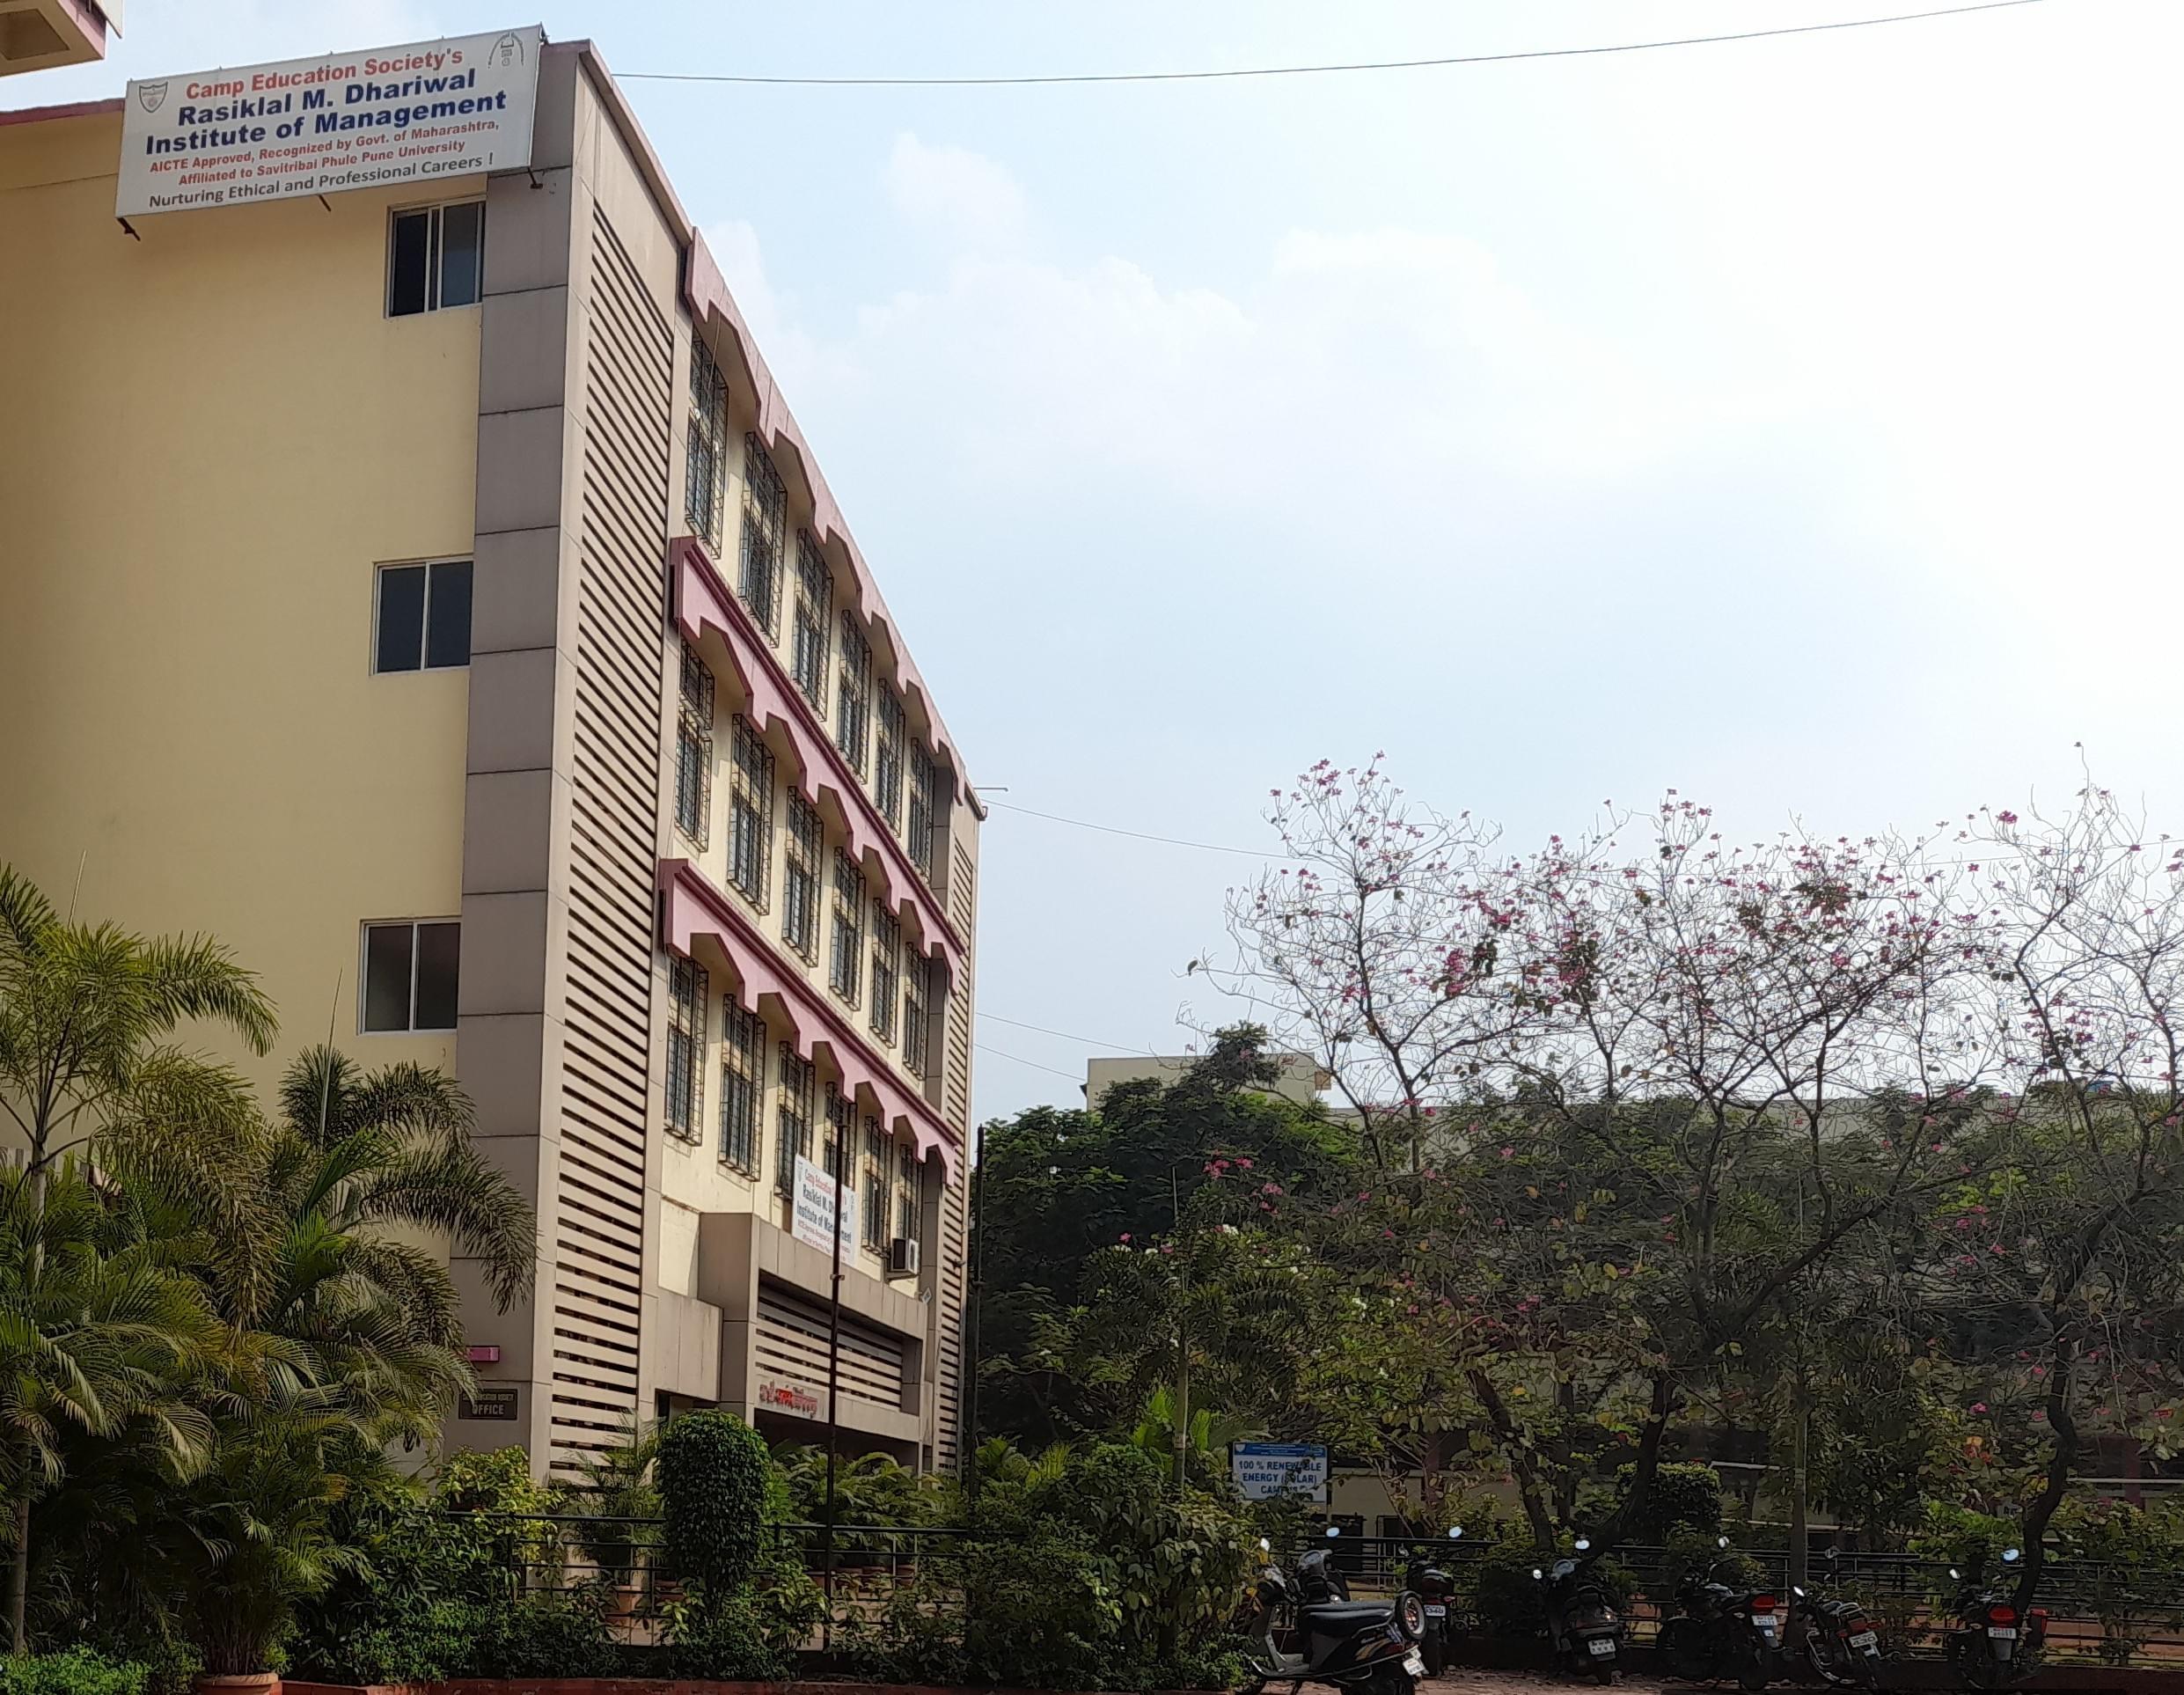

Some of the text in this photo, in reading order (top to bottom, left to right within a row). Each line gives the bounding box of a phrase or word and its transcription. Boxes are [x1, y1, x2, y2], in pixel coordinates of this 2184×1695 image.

[179, 68, 476, 127] Rasiklal M. Dhariwal
[186, 48, 463, 99] Camp Education Society's
[146, 90, 507, 155] Institute of Management
[150, 121, 499, 172] AICTE Approved, Recognized by Govt. of Maharashtra,
[149, 189, 224, 208] Nurturing
[228, 180, 280, 199] Ethical
[283, 176, 314, 192] and
[319, 163, 416, 187] Professional
[421, 157, 483, 173] Careers
[179, 140, 465, 186] Affiliated to Savitribai Phule Pune University
[472, 1404, 504, 1415] OFFICE
[1239, 1460, 1254, 1470] 100
[1242, 1472, 1279, 1482] ENERGY
